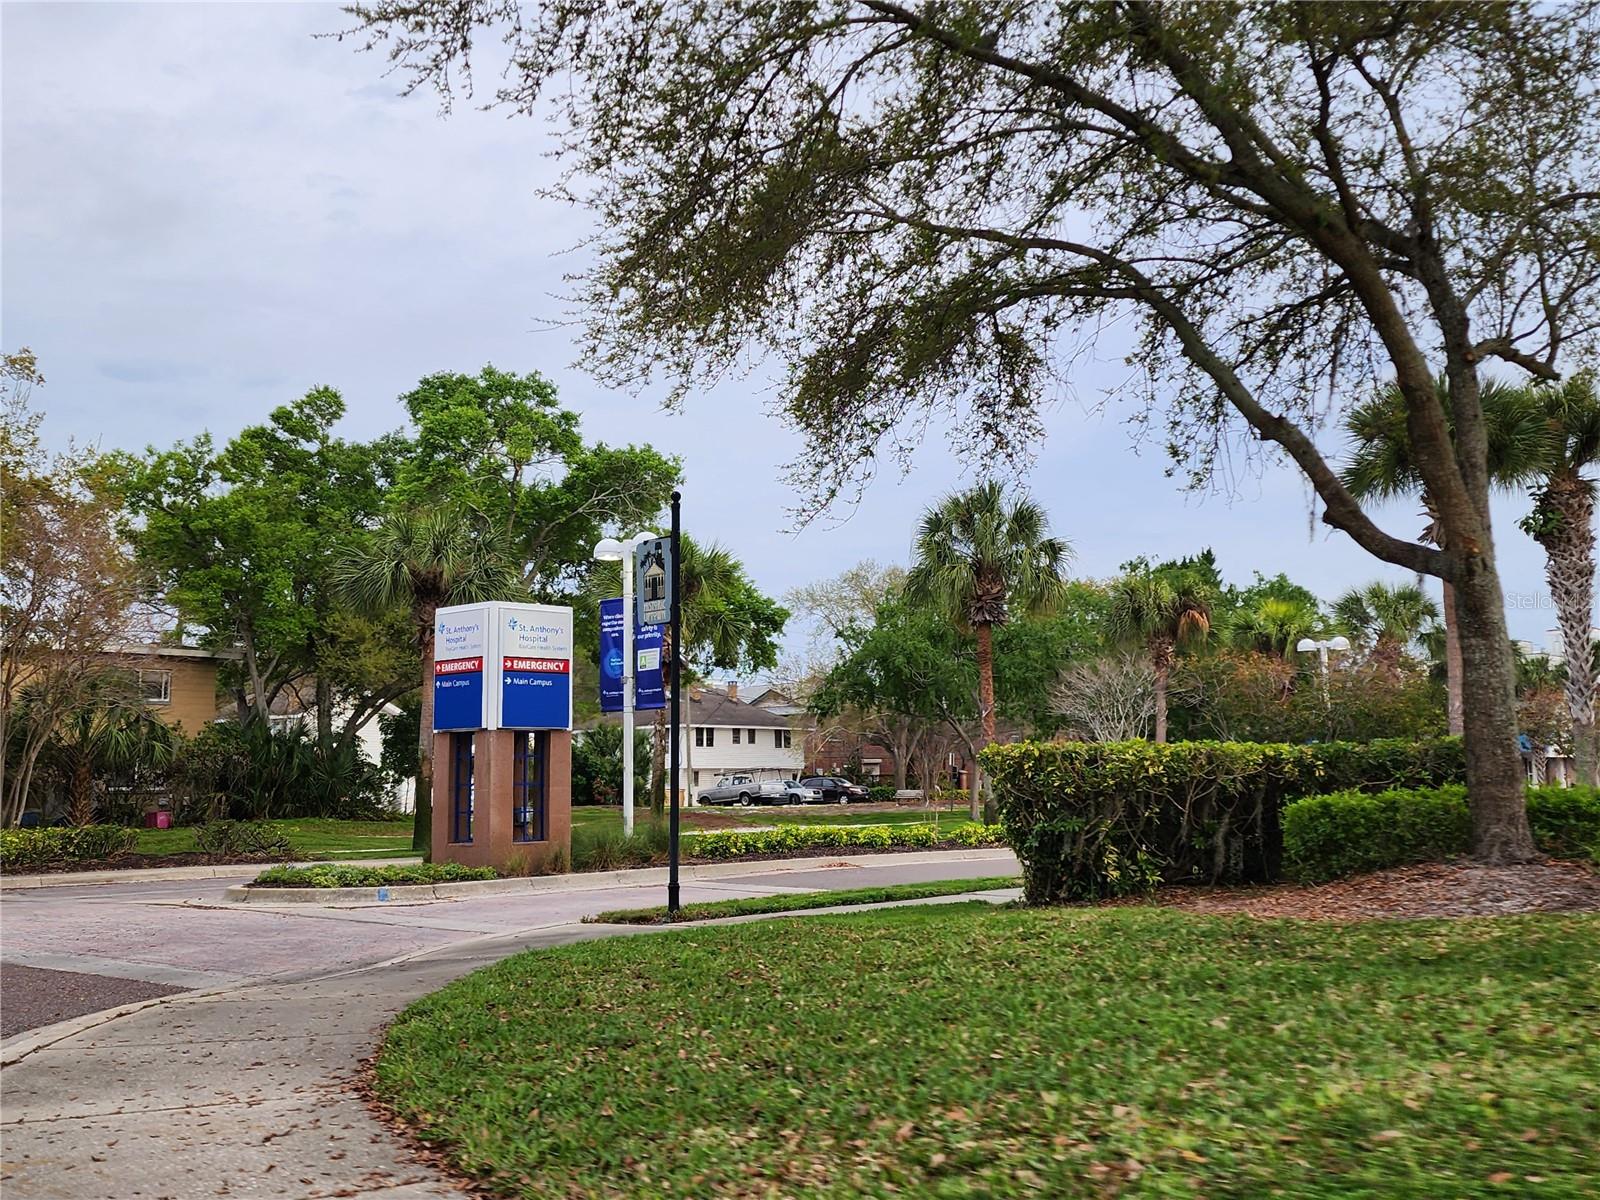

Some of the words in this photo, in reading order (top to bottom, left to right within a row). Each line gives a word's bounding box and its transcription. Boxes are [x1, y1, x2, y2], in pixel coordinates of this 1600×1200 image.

[454, 624, 480, 634] Anthony's
[530, 625, 564, 635] Anthony's
[446, 636, 466, 645] Hospital
[519, 634, 548, 644] Hospital
[442, 660, 479, 672] EMERGENCY
[513, 660, 564, 671] EMERGENCY
[452, 680, 470, 688] Campus
[513, 678, 528, 686] Main
[529, 678, 552, 687] Campus
